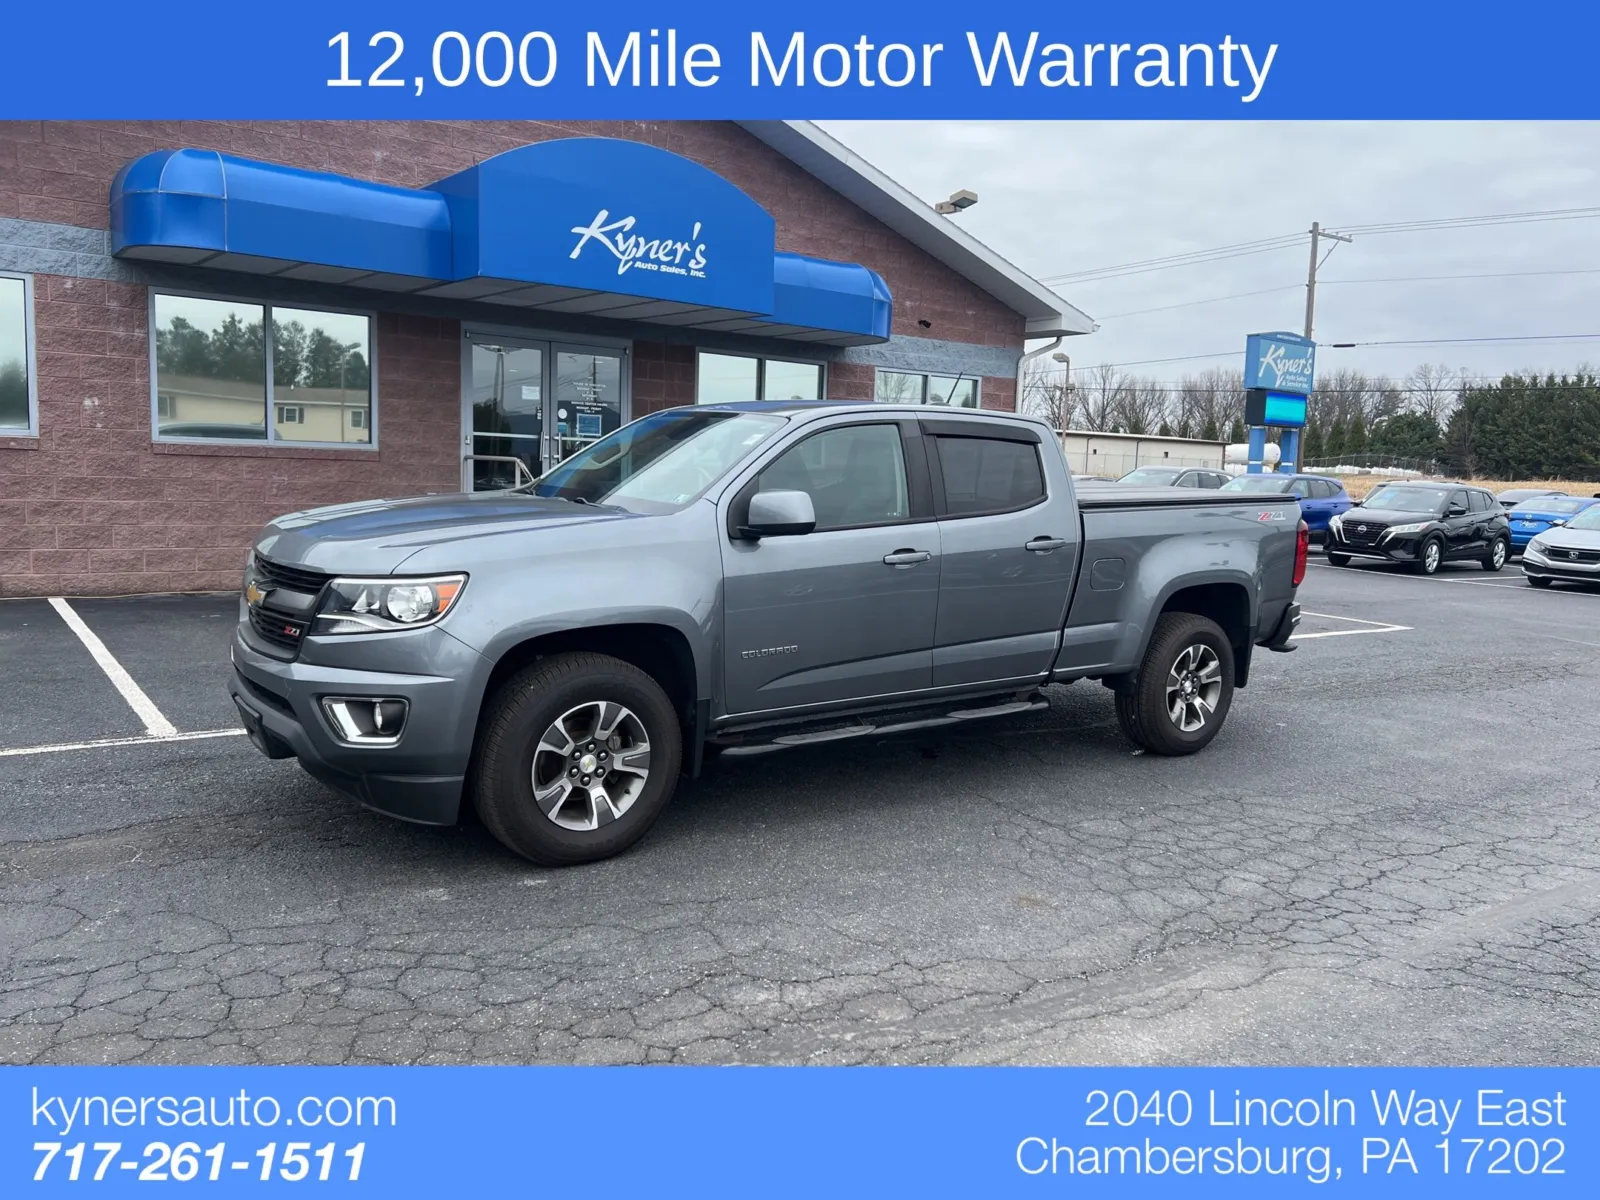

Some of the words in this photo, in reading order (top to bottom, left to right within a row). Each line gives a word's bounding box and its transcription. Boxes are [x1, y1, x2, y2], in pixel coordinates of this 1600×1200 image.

[569, 209, 707, 275] Kyner's
[634, 261, 658, 271] Auto
[660, 265, 688, 277] Sales,
[690, 269, 706, 278] Inc.
[1258, 344, 1312, 388] Kyner's
[1258, 511, 1286, 522] Z71
[741, 645, 798, 659] COLORADO
